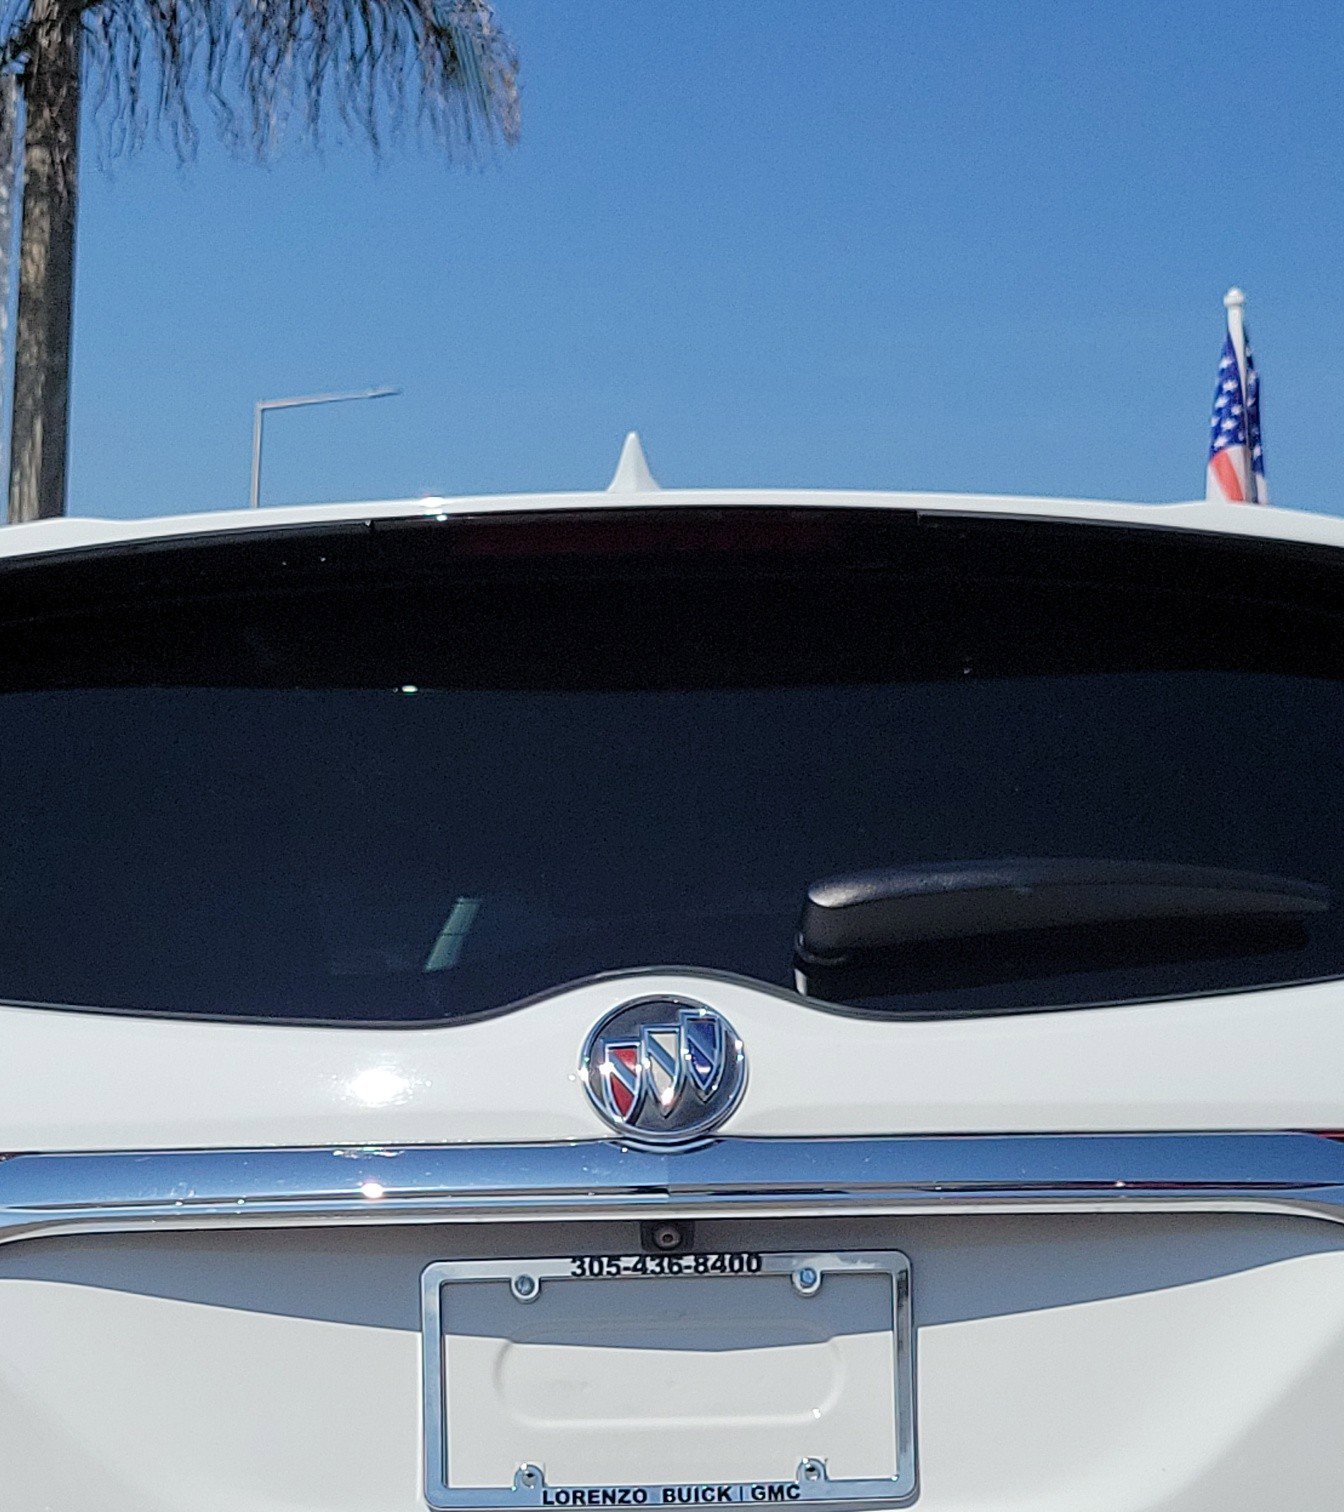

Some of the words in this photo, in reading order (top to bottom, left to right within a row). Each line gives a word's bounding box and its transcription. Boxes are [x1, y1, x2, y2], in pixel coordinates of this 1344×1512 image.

[570, 1252, 763, 1278] 305-436-8400
[542, 1488, 648, 1506] LORENZO
[662, 1486, 733, 1504] BUICK
[751, 1484, 801, 1502] GMC
